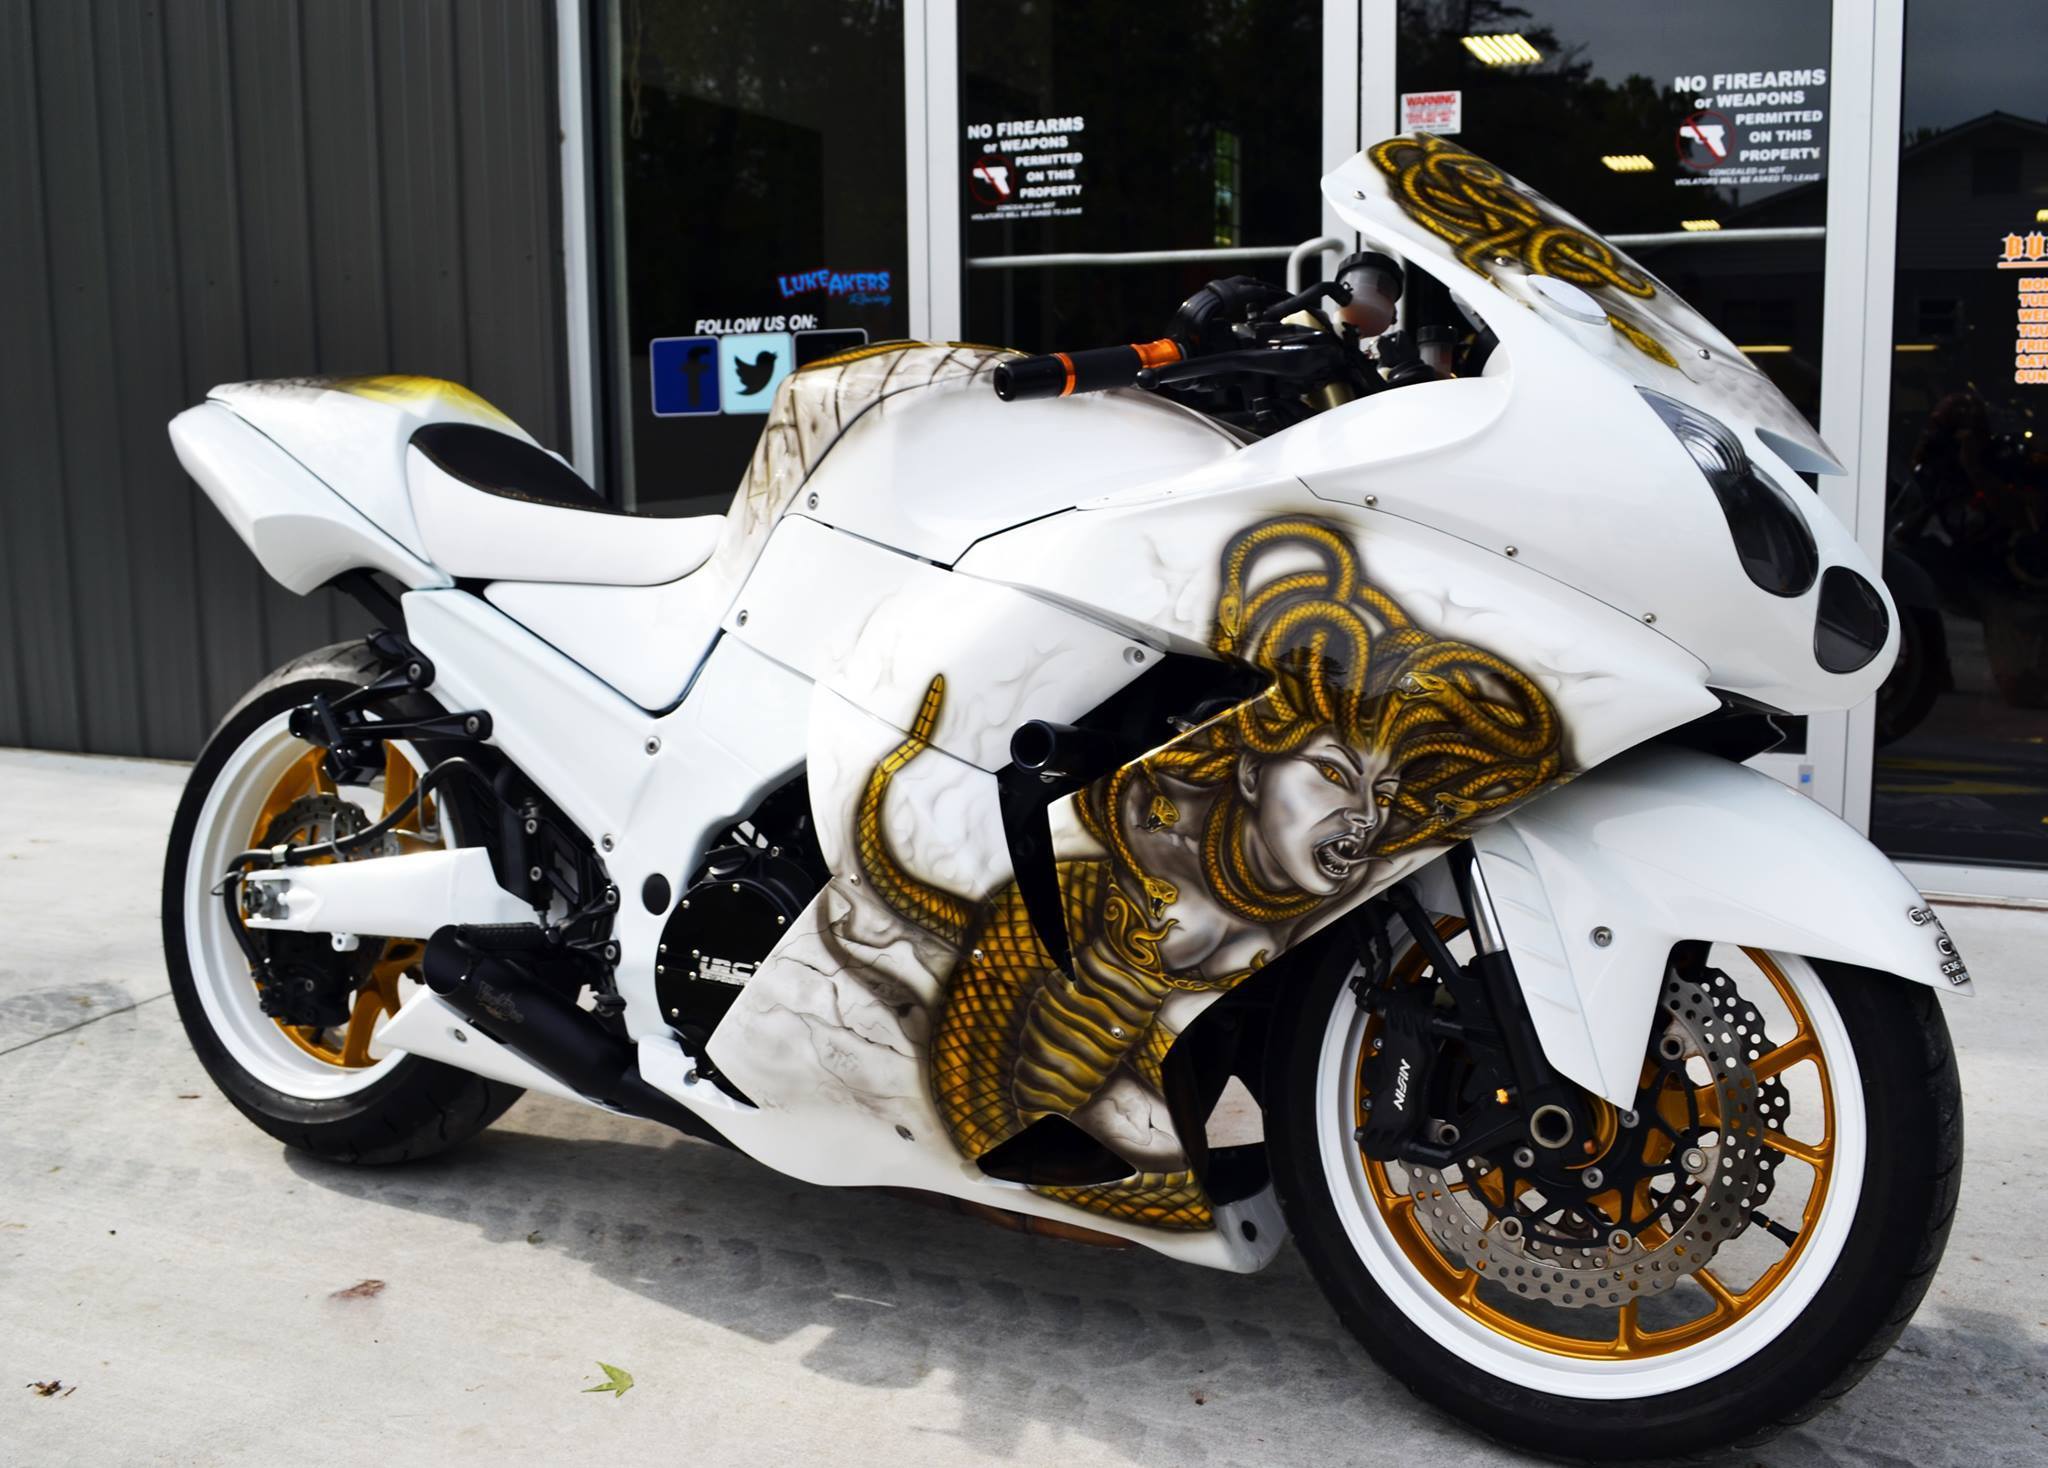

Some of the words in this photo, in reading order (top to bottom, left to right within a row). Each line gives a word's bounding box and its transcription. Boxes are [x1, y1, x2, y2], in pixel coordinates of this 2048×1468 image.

[1674, 75, 1707, 93] NO
[1712, 68, 1827, 91] FIREARMS
[1694, 98, 1713, 109] or
[1716, 90, 1805, 108] WEAPONS
[1735, 110, 1823, 126] PERMITTED
[967, 124, 993, 139] NO
[996, 116, 1085, 137] FIREARMS
[983, 143, 998, 153] or
[1000, 135, 1069, 152] WEAPONS
[1749, 131, 1772, 143] ON
[1775, 129, 1812, 142] THIS
[1015, 152, 1084, 167] PERMITTED
[1739, 147, 1821, 162] PROPERTY
[1026, 171, 1045, 182] ON
[1047, 169, 1075, 181] THIS
[1708, 167, 1758, 177] CONCEALED
[1768, 165, 1786, 174] NOT
[1019, 184, 1082, 198] PROPERTY
[1999, 230, 2048, 262] BU
[695, 317, 762, 335] FOLLOW
[764, 315, 786, 332] US
[789, 314, 818, 331] ON:
[2015, 354, 2048, 368] SAT
[1393, 1058, 1411, 1111] NISSIN
